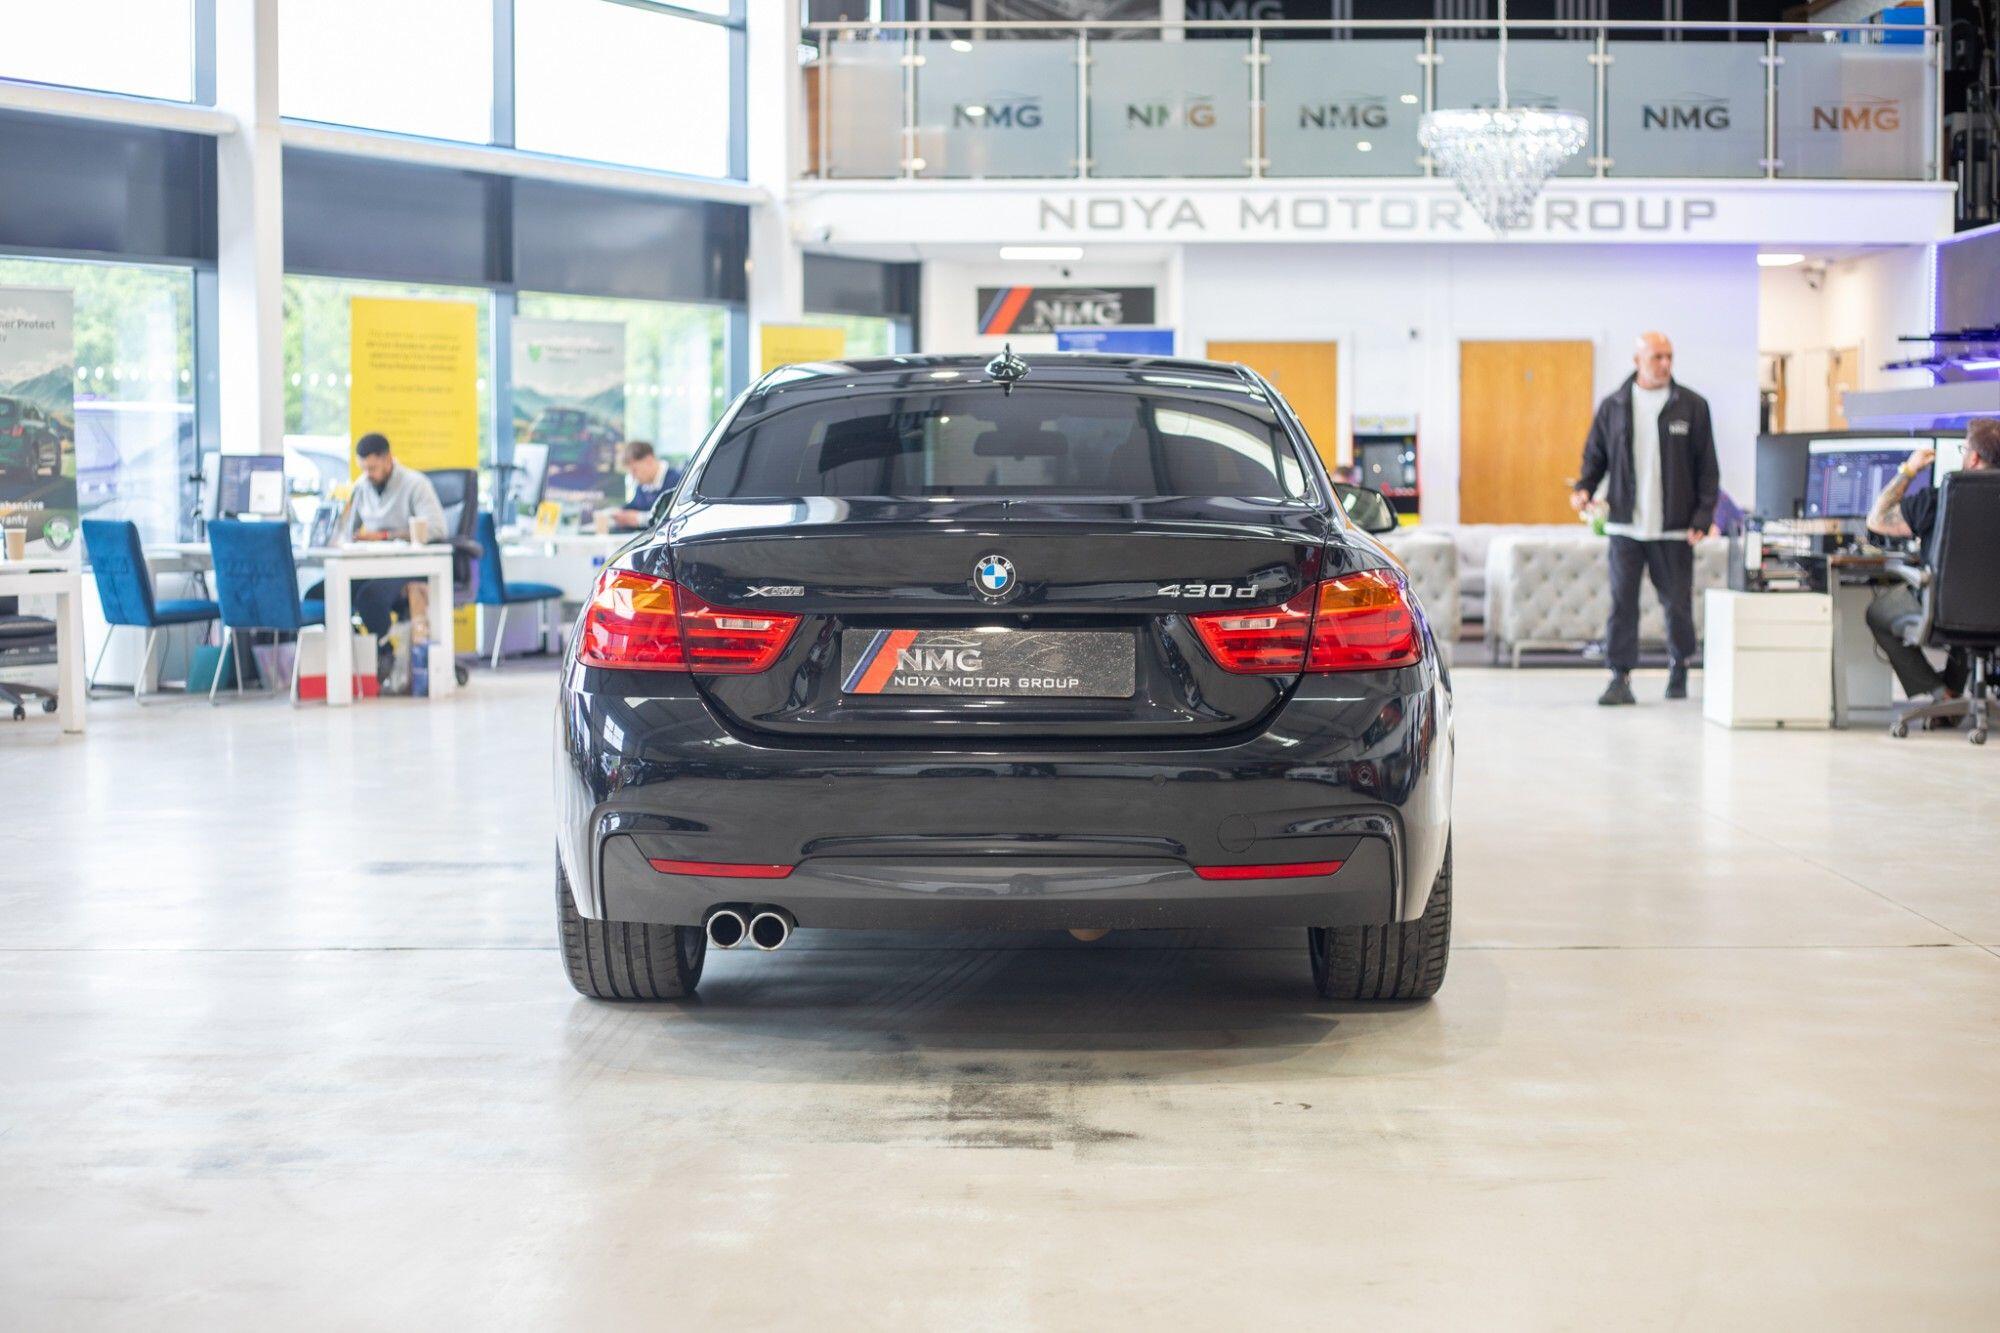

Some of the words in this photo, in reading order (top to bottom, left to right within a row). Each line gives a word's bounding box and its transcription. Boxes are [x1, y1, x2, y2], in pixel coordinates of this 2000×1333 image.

[953, 104, 1042, 128] NMG
[1300, 104, 1388, 129] NMG
[1642, 105, 1730, 130] NMG
[1813, 106, 1900, 132] NMG
[1039, 198, 1205, 230] NOYA
[1239, 198, 1464, 230] MOTOR
[18, 319, 55, 330] Protect
[1033, 299, 1122, 326] NMG
[0, 514, 28, 527] ranty
[1157, 584, 1259, 598] 430d
[896, 649, 983, 671] NMG
[894, 677, 939, 687] NOYA
[949, 677, 1010, 688] MOTOR
[1018, 678, 1079, 688] GROUP
